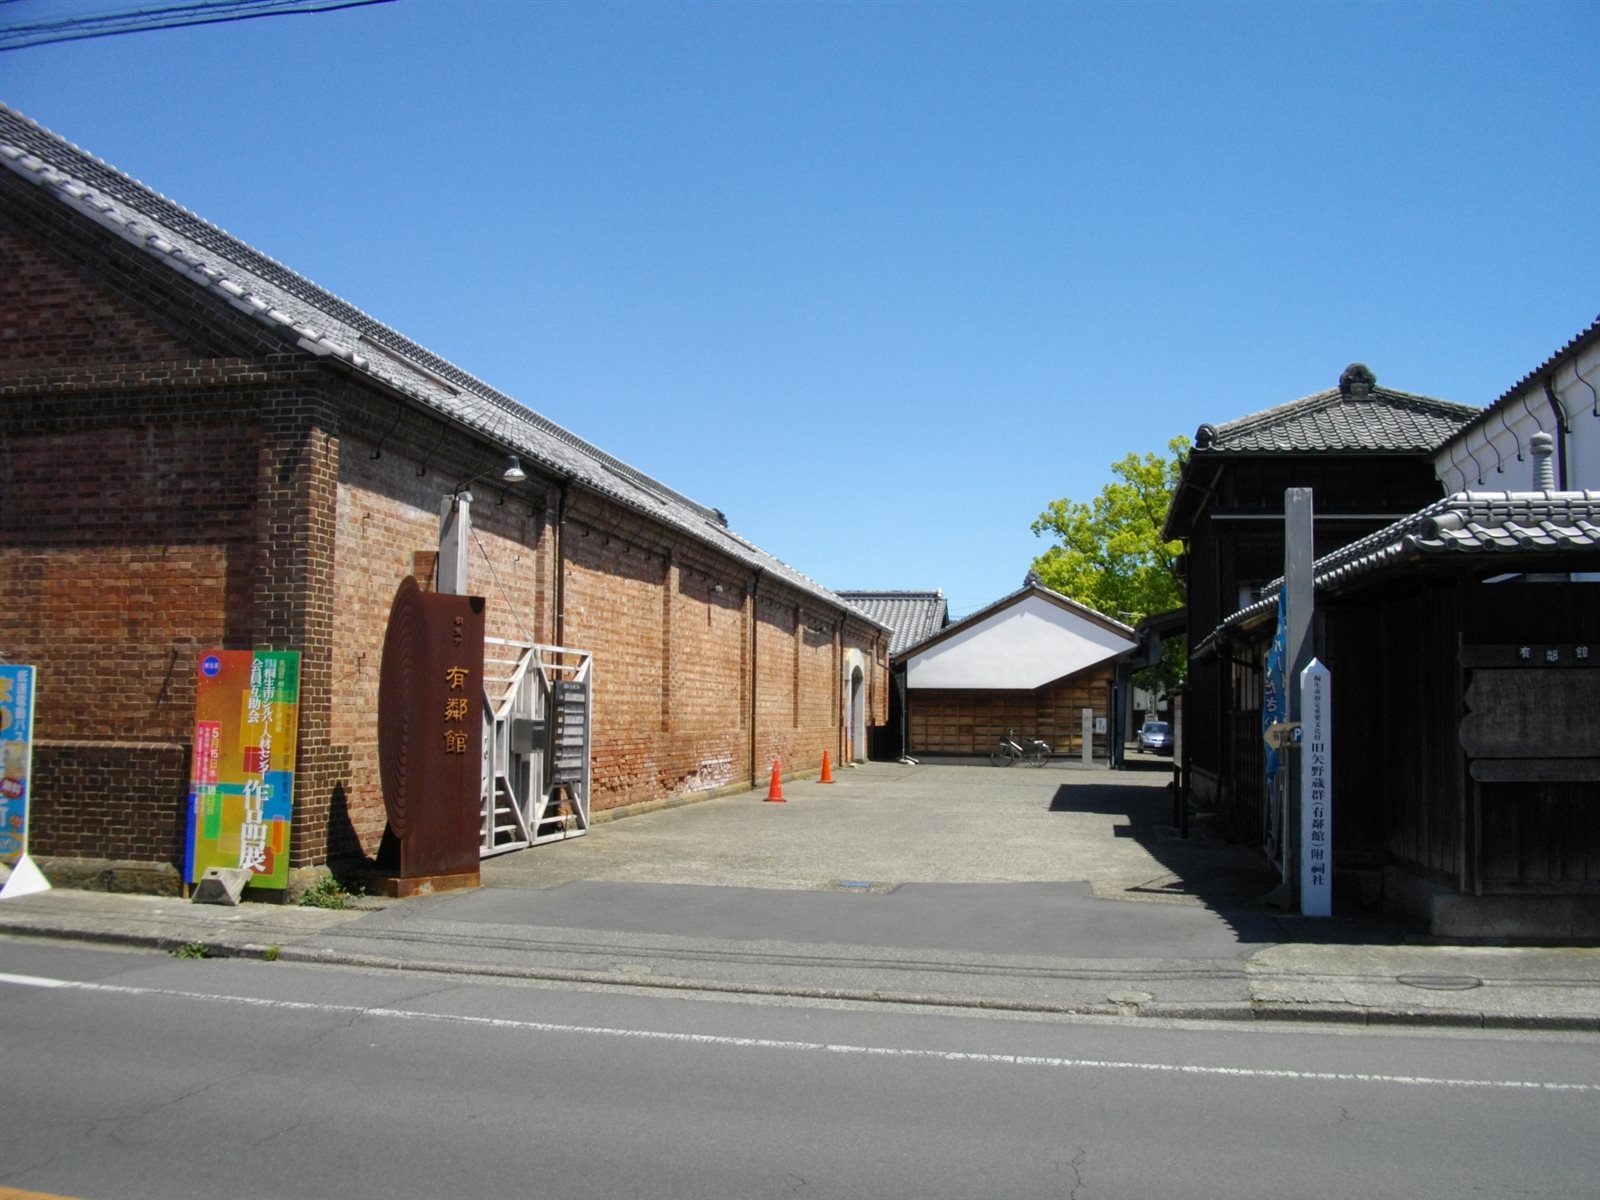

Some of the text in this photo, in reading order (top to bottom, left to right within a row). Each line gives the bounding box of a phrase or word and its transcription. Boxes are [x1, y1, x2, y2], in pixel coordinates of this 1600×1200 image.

[246, 658, 263, 724] 会員互助会
[258, 667, 278, 780] 桐生市シルバー人材センター
[241, 779, 270, 872] 作品展
